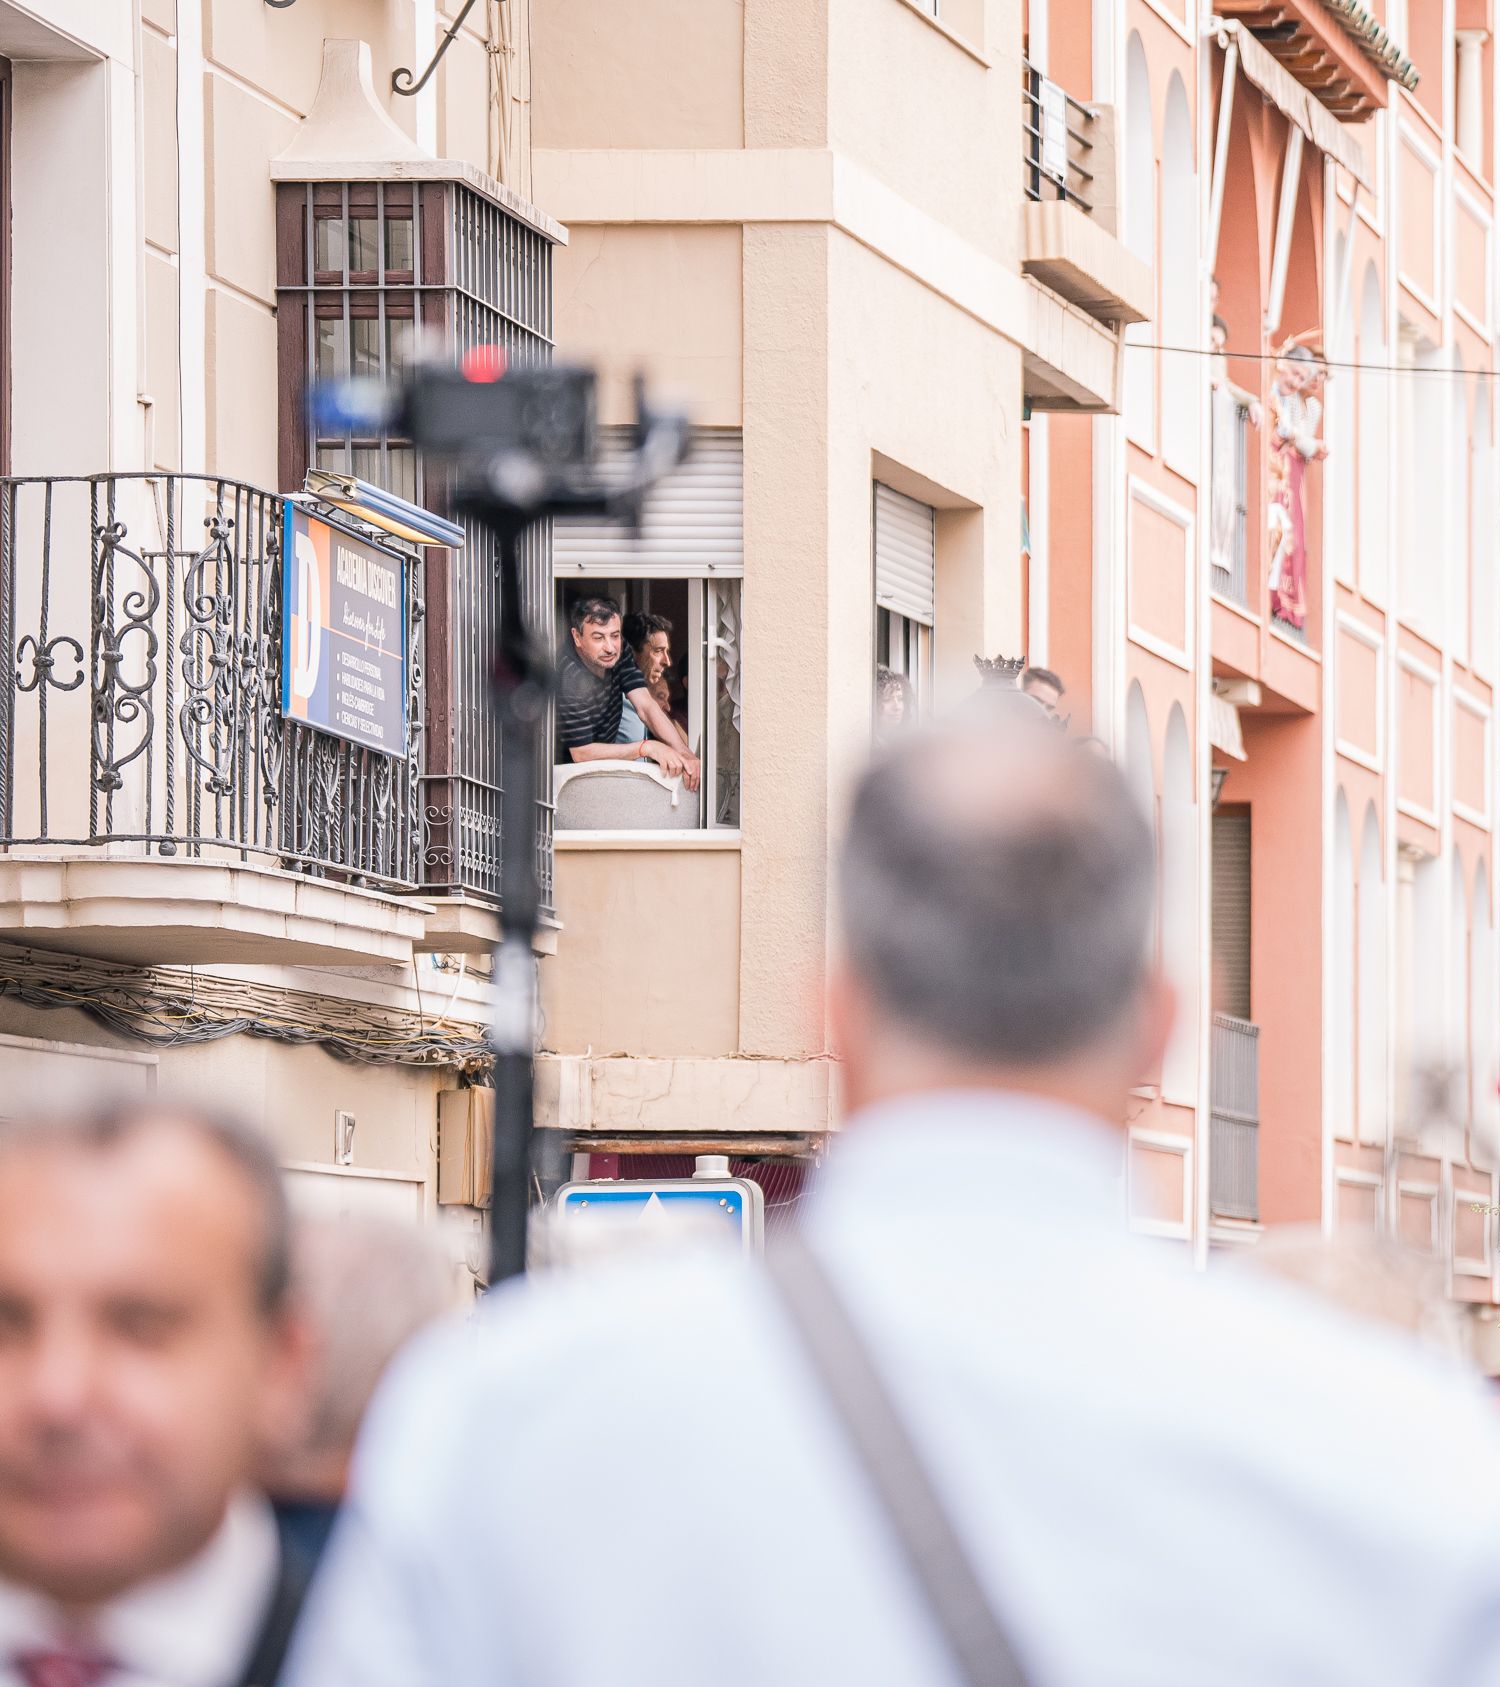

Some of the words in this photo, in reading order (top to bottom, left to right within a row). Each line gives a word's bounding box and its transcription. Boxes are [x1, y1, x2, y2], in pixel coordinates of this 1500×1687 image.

[337, 546, 368, 596] ACADEMIA
[368, 561, 396, 609] DISCOVER
[342, 652, 364, 673] DESARROLLO
[364, 660, 382, 681] PERSONAL
[342, 672, 363, 692] HABILIDADES
[342, 711, 358, 729] CIENCIAS
[361, 719, 384, 738] SELECTIVIDAD
